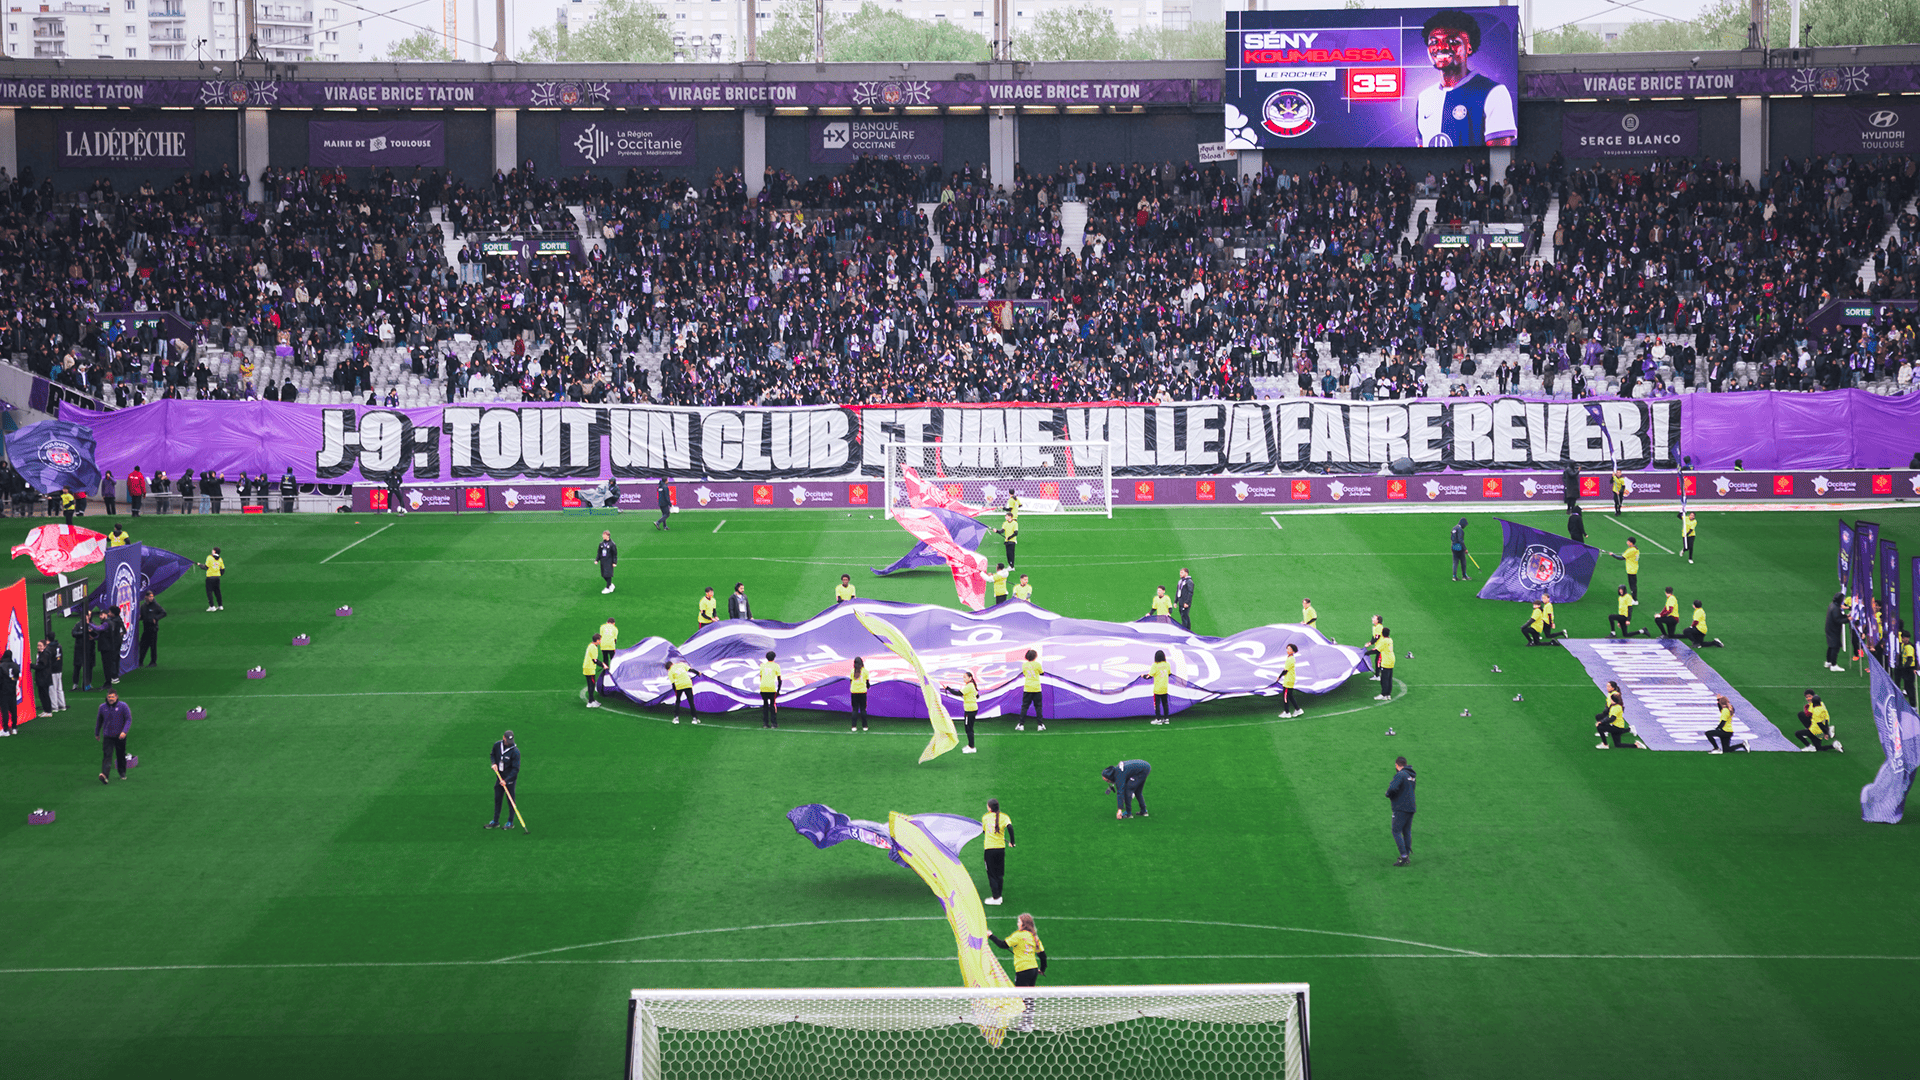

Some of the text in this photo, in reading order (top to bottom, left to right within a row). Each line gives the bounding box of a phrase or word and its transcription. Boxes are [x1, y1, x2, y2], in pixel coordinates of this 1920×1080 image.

[1244, 31, 1318, 49] SÉNY
[1244, 48, 1396, 63] KOUMBASSA
[1280, 70, 1328, 78] ROCHER
[1353, 74, 1397, 93] 35
[1584, 75, 1734, 91] VIRAGE BRICE TATON
[51, 85, 93, 99] BRICE
[97, 85, 144, 99] TATON
[324, 87, 475, 100] VIRAGE BRICE TATON
[668, 86, 721, 100] VIRAGE
[989, 84, 1140, 99] VIRAGE BRICE TATON
[852, 122, 899, 131] BANQUE
[627, 131, 653, 139] Région
[852, 131, 915, 140] POPULAIRE
[1861, 131, 1905, 139] HYUNDAI
[65, 128, 186, 157] LA DÉPÊCHE
[617, 138, 682, 150] Occitanie
[1580, 134, 1681, 146] SERGE BLANCO
[852, 141, 896, 149] OCCITANE
[1861, 141, 1905, 149] TOULOUSE
[1493, 235, 1519, 243] SORTIE
[1845, 308, 1871, 316] SORTIE
[445, 407, 598, 470] TOUT
[610, 408, 692, 470] UN
[702, 409, 850, 472] CLUB
[861, 408, 933, 468] ET
[942, 408, 1055, 468] UNE
[1066, 405, 1223, 466] VILLE
[1228, 403, 1272, 464] A
[1279, 402, 1444, 465] FAIRE
[1453, 399, 1645, 461] RÊVER
[1438, 484, 1467, 492] Occitanie
[1827, 480, 1857, 488] Occitanie
[1247, 486, 1276, 494] Occitanie
[1342, 485, 1372, 493] Occitanie
[421, 494, 450, 502] Occitanie
[805, 490, 833, 498] Occitanie
